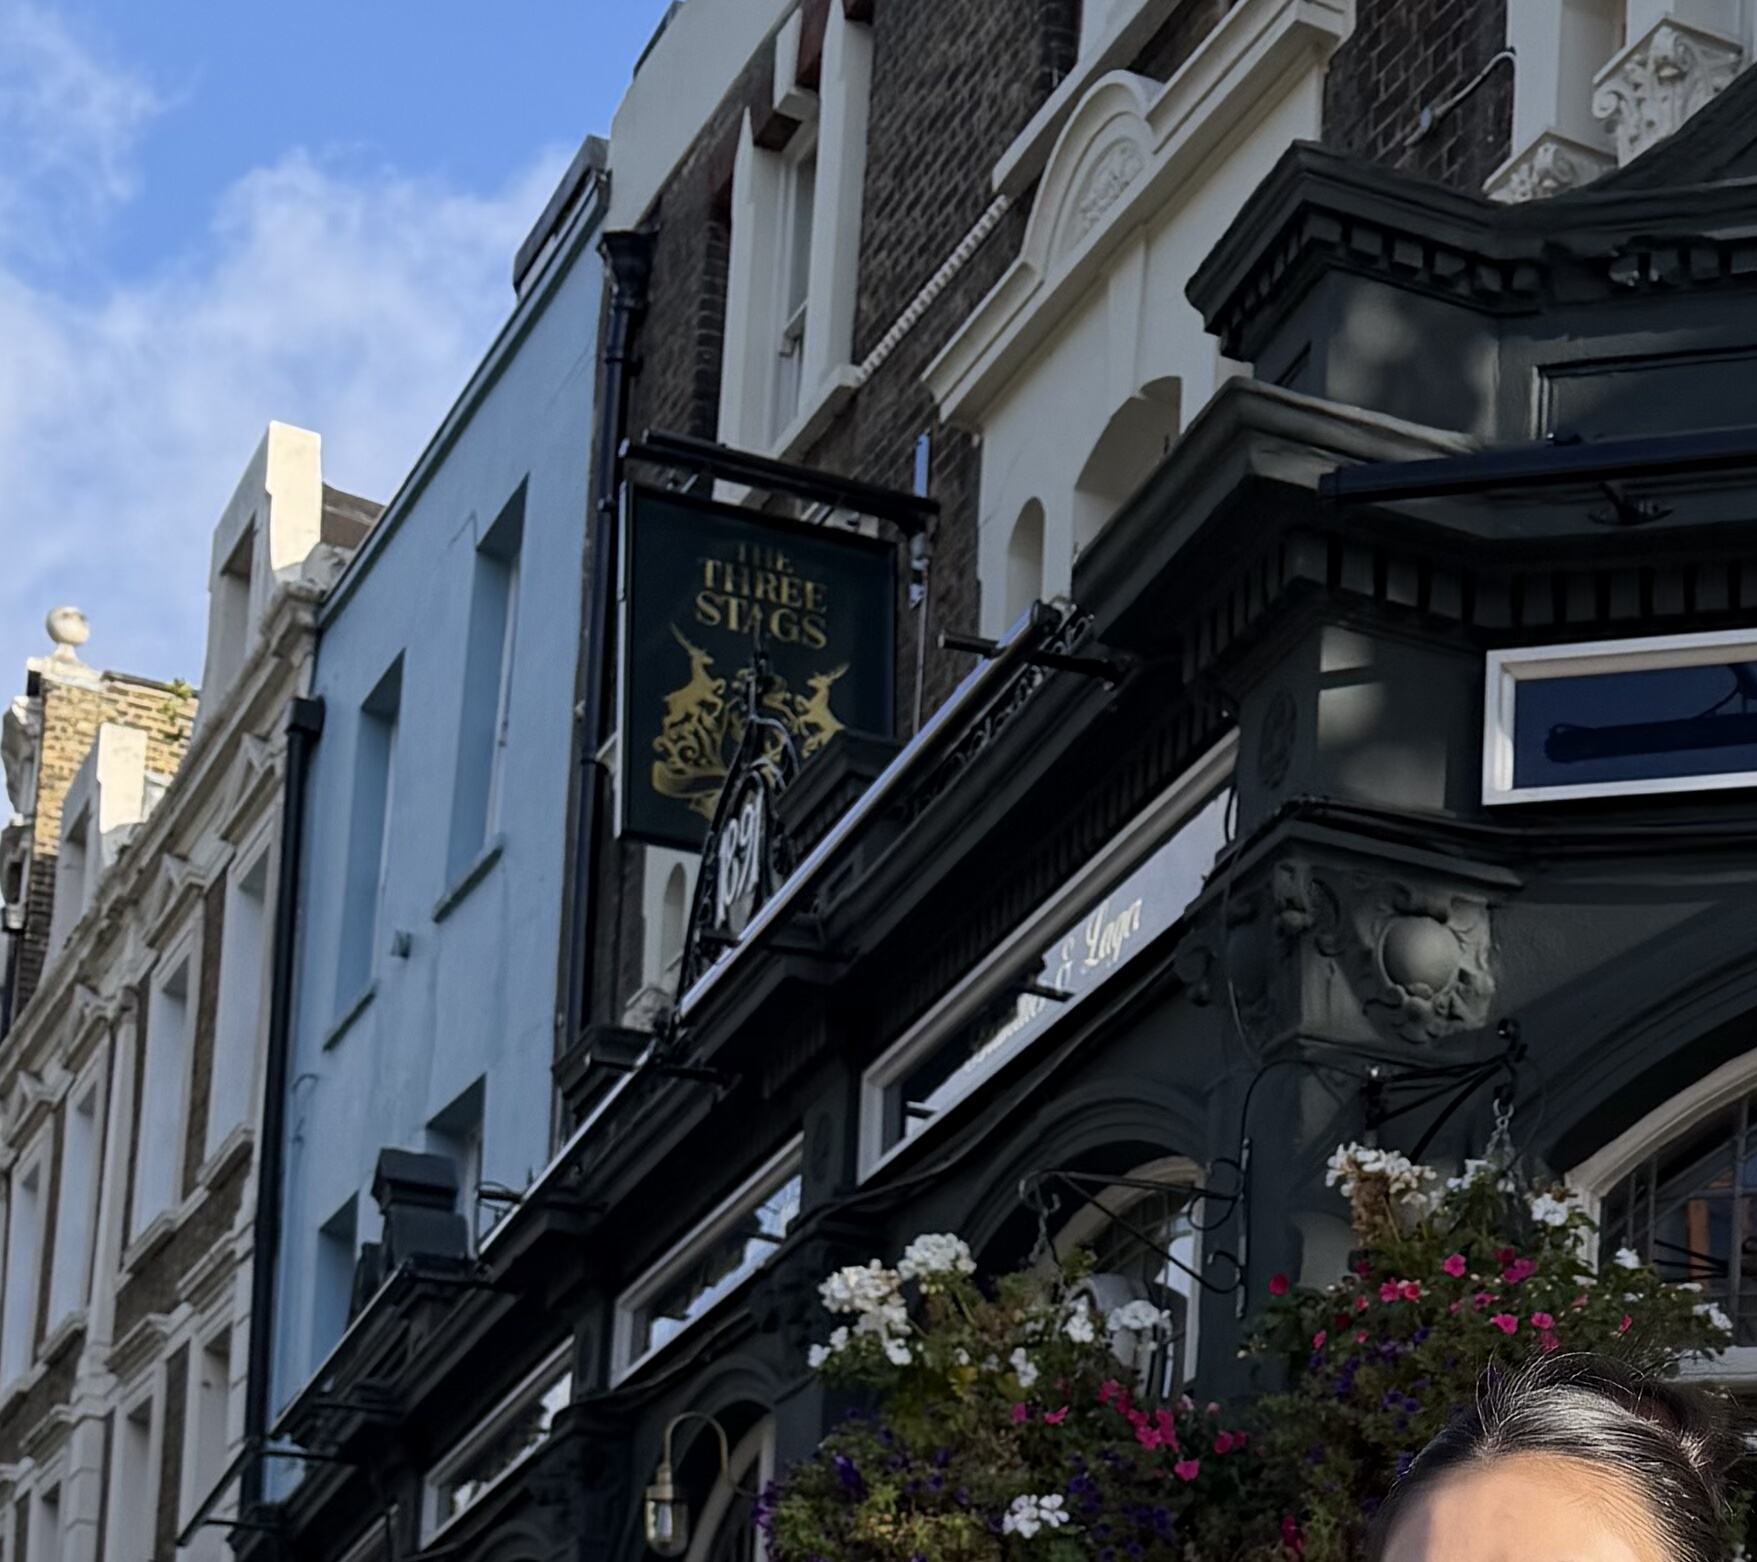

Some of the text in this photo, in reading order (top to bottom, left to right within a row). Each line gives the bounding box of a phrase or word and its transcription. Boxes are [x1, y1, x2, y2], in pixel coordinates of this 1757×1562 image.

[699, 557, 828, 614] THREE
[738, 541, 796, 574] THE
[695, 591, 828, 649] STAGS
